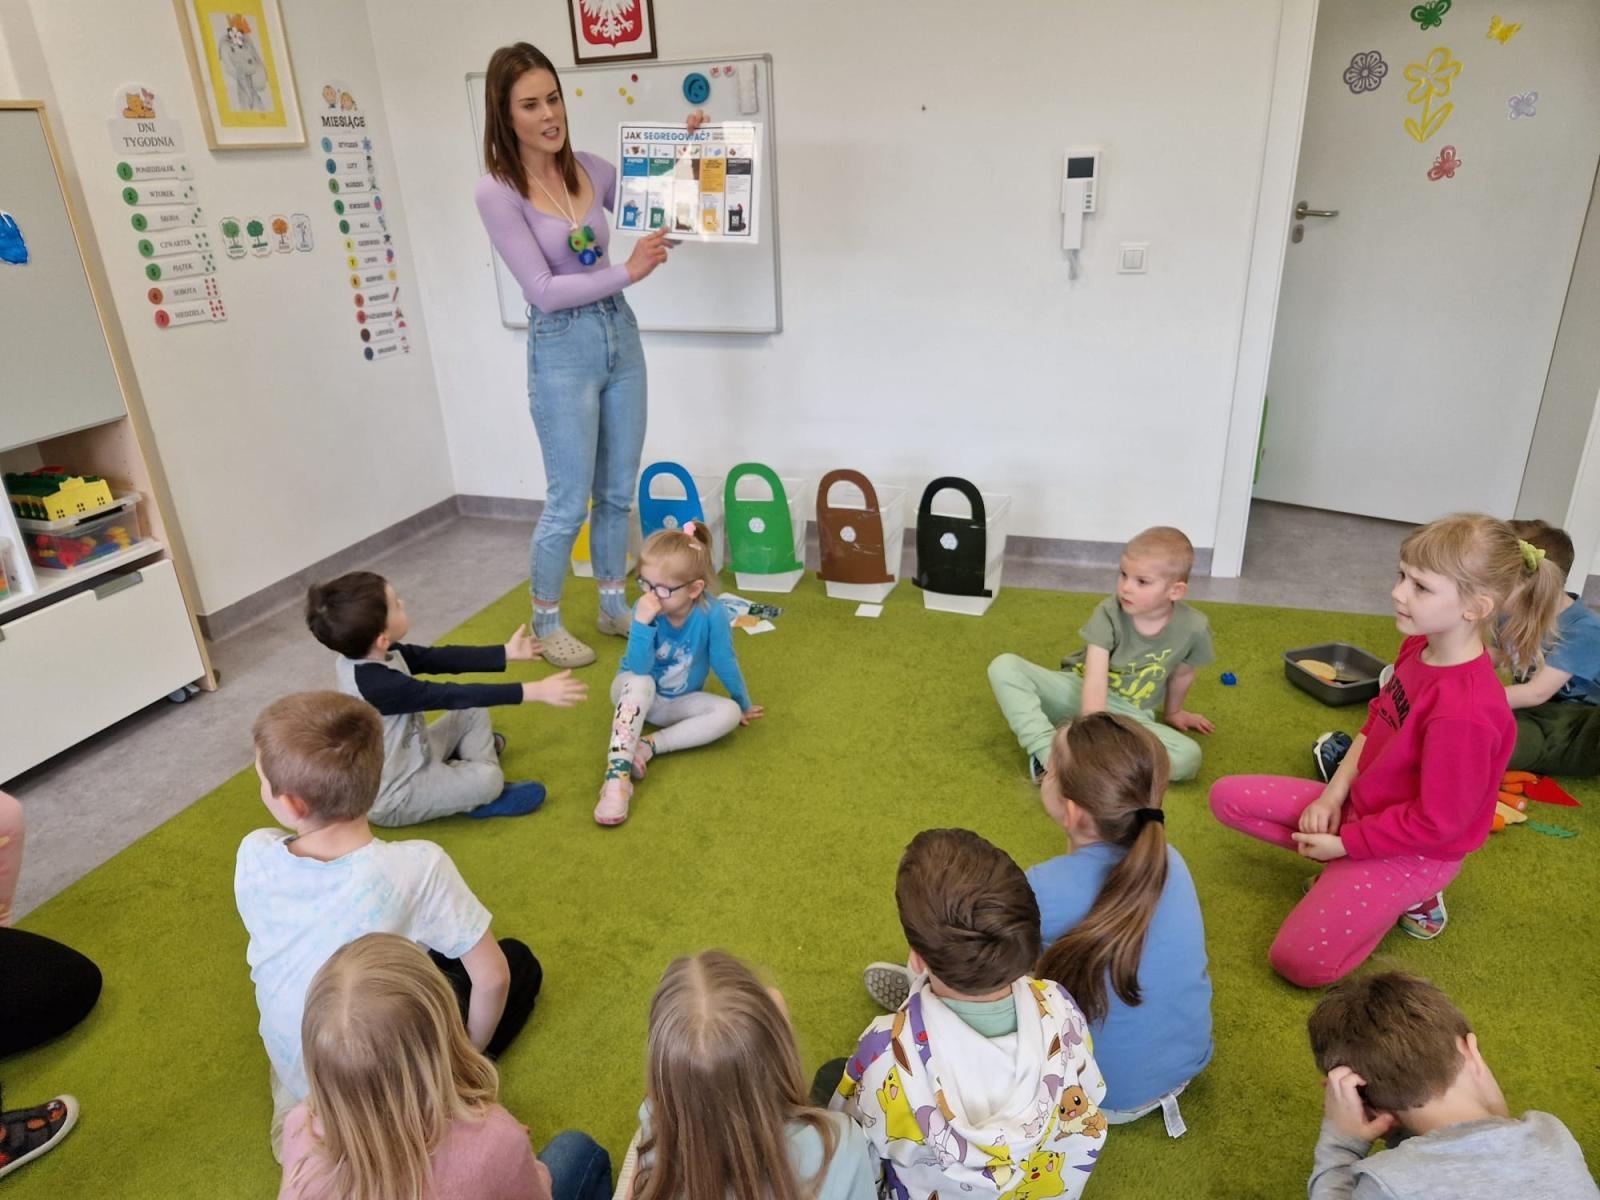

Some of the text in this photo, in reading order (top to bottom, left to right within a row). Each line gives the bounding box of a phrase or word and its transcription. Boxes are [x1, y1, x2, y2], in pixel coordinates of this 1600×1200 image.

[137, 122, 156, 133] DNI
[320, 115, 367, 129] MIESIĄCE
[624, 131, 641, 140] JAK
[643, 130, 711, 141] SEGREGOWAĆ?
[122, 136, 175, 148] TYGODNIA
[159, 239, 192, 249] CZWARTEK
[173, 287, 197, 296] SOBOTA
